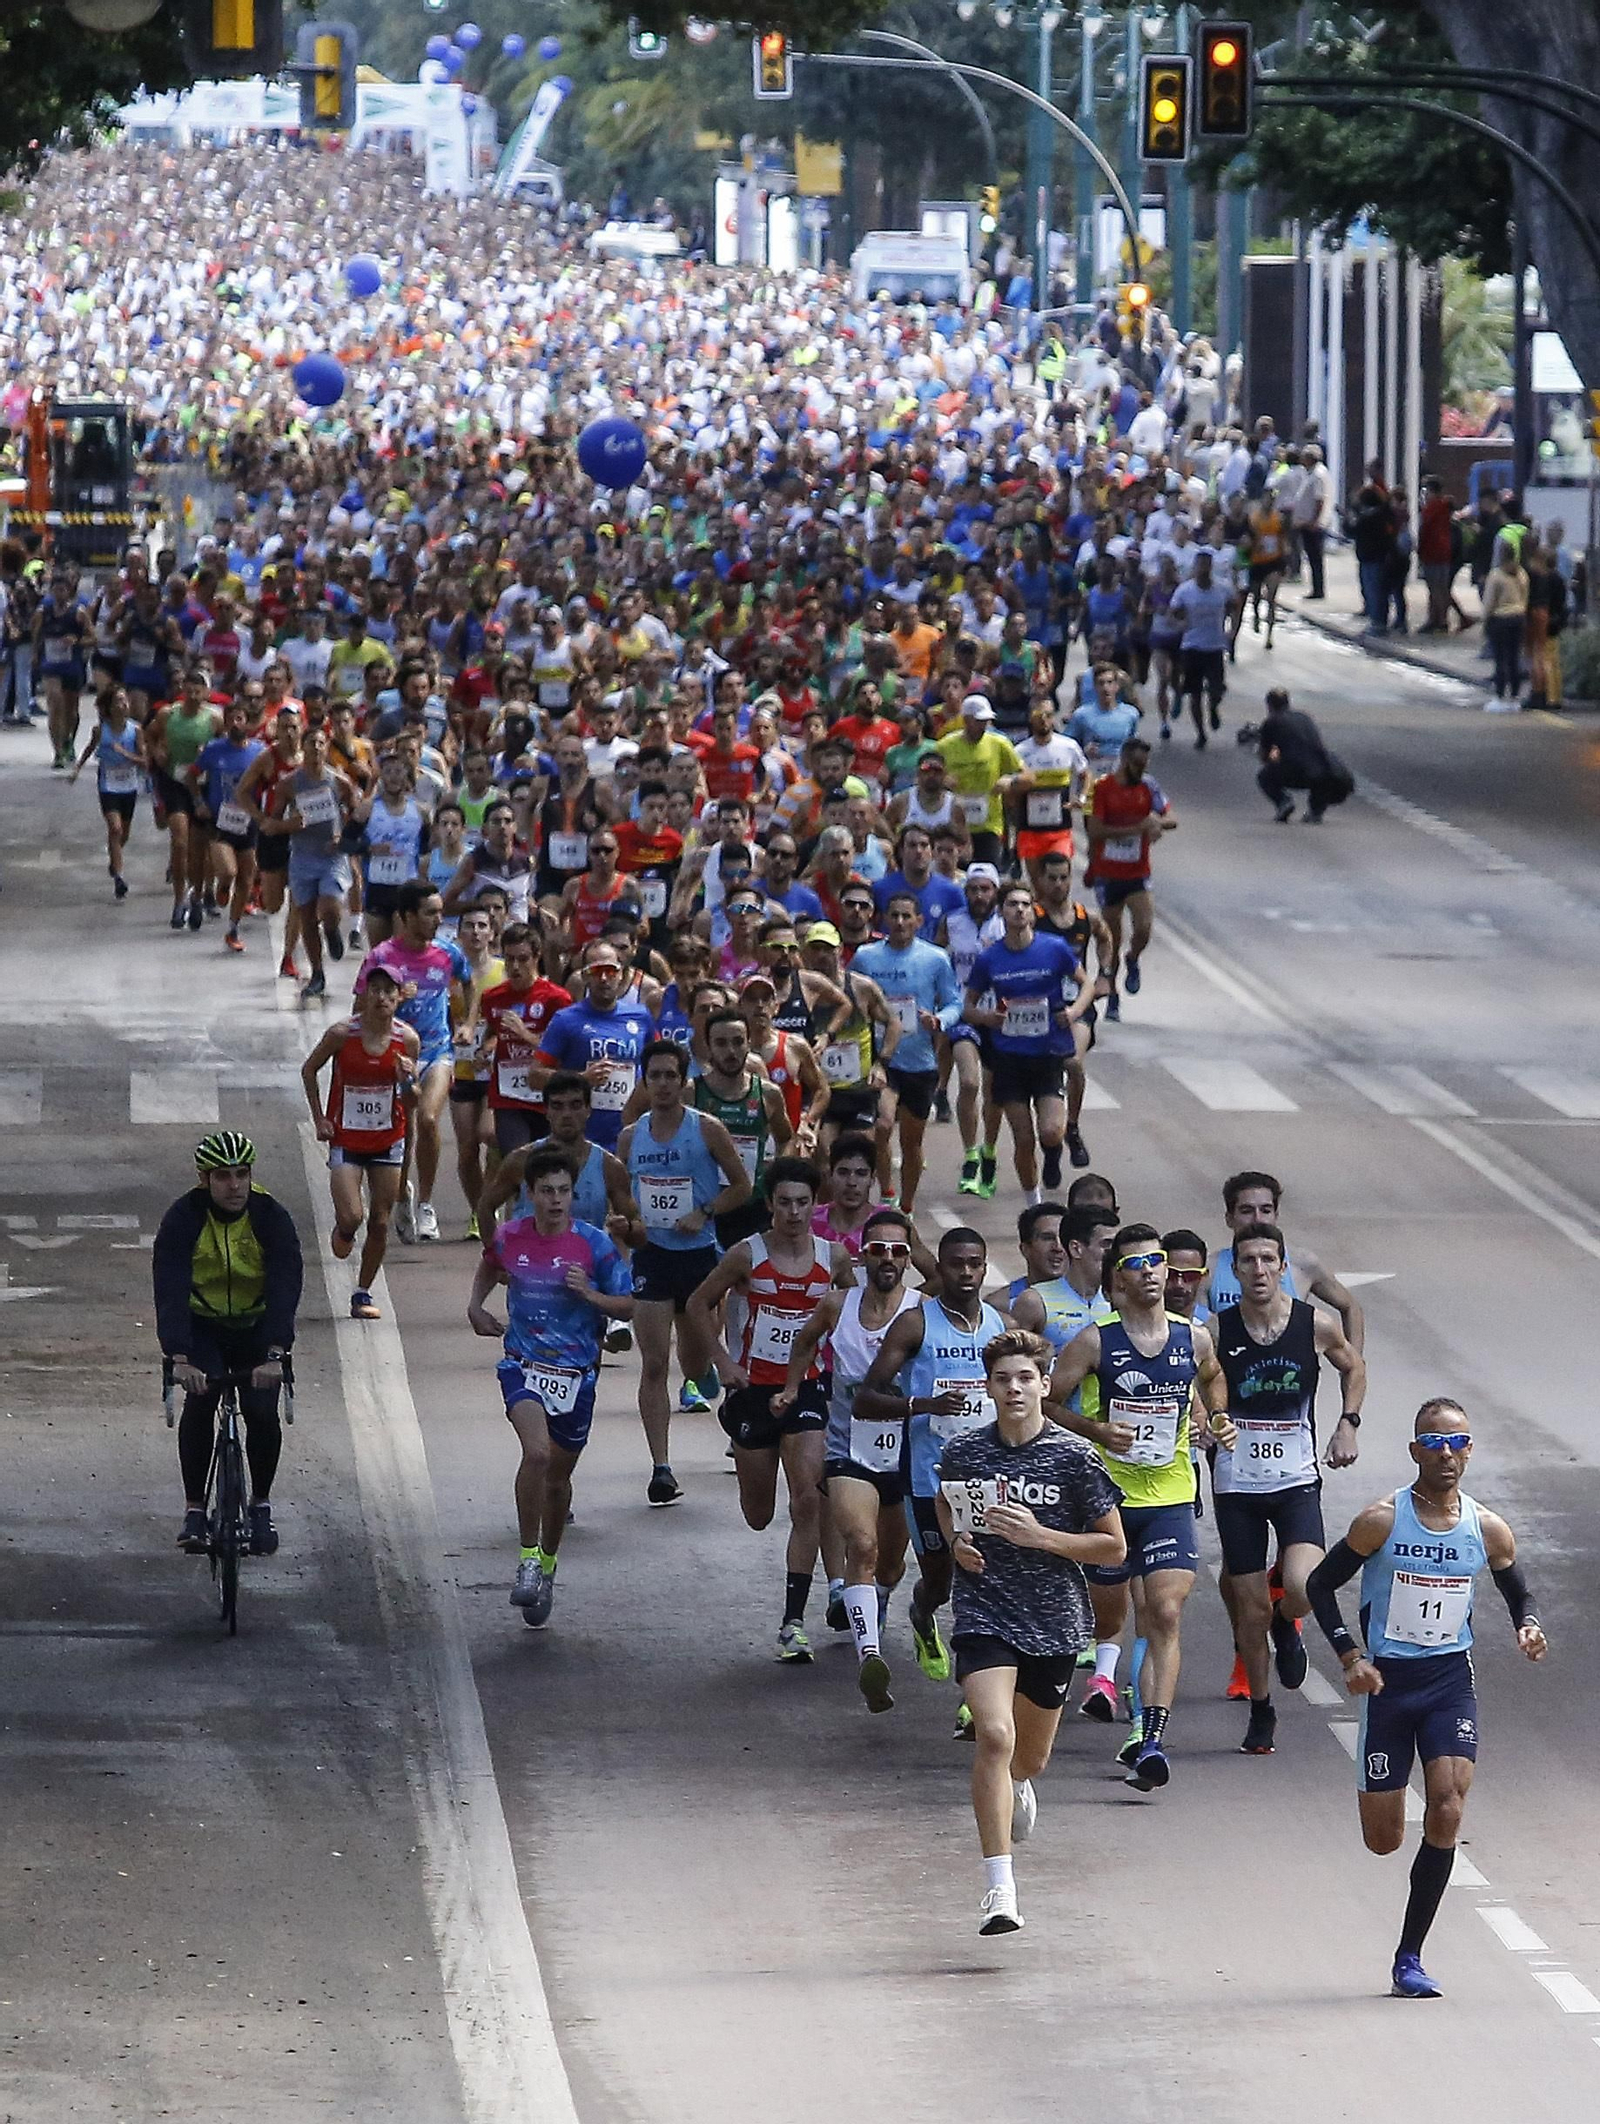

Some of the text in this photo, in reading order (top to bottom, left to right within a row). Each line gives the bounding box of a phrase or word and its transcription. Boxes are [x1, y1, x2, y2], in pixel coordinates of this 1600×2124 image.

[356, 1101, 382, 1115] 305
[638, 1148, 681, 1166] nerja
[650, 1194, 679, 1210] 362
[873, 1433, 896, 1450] 40
[1249, 1442, 1284, 1459] 386
[1393, 1542, 1460, 1564] nerja
[1418, 1600, 1443, 1620] 11
